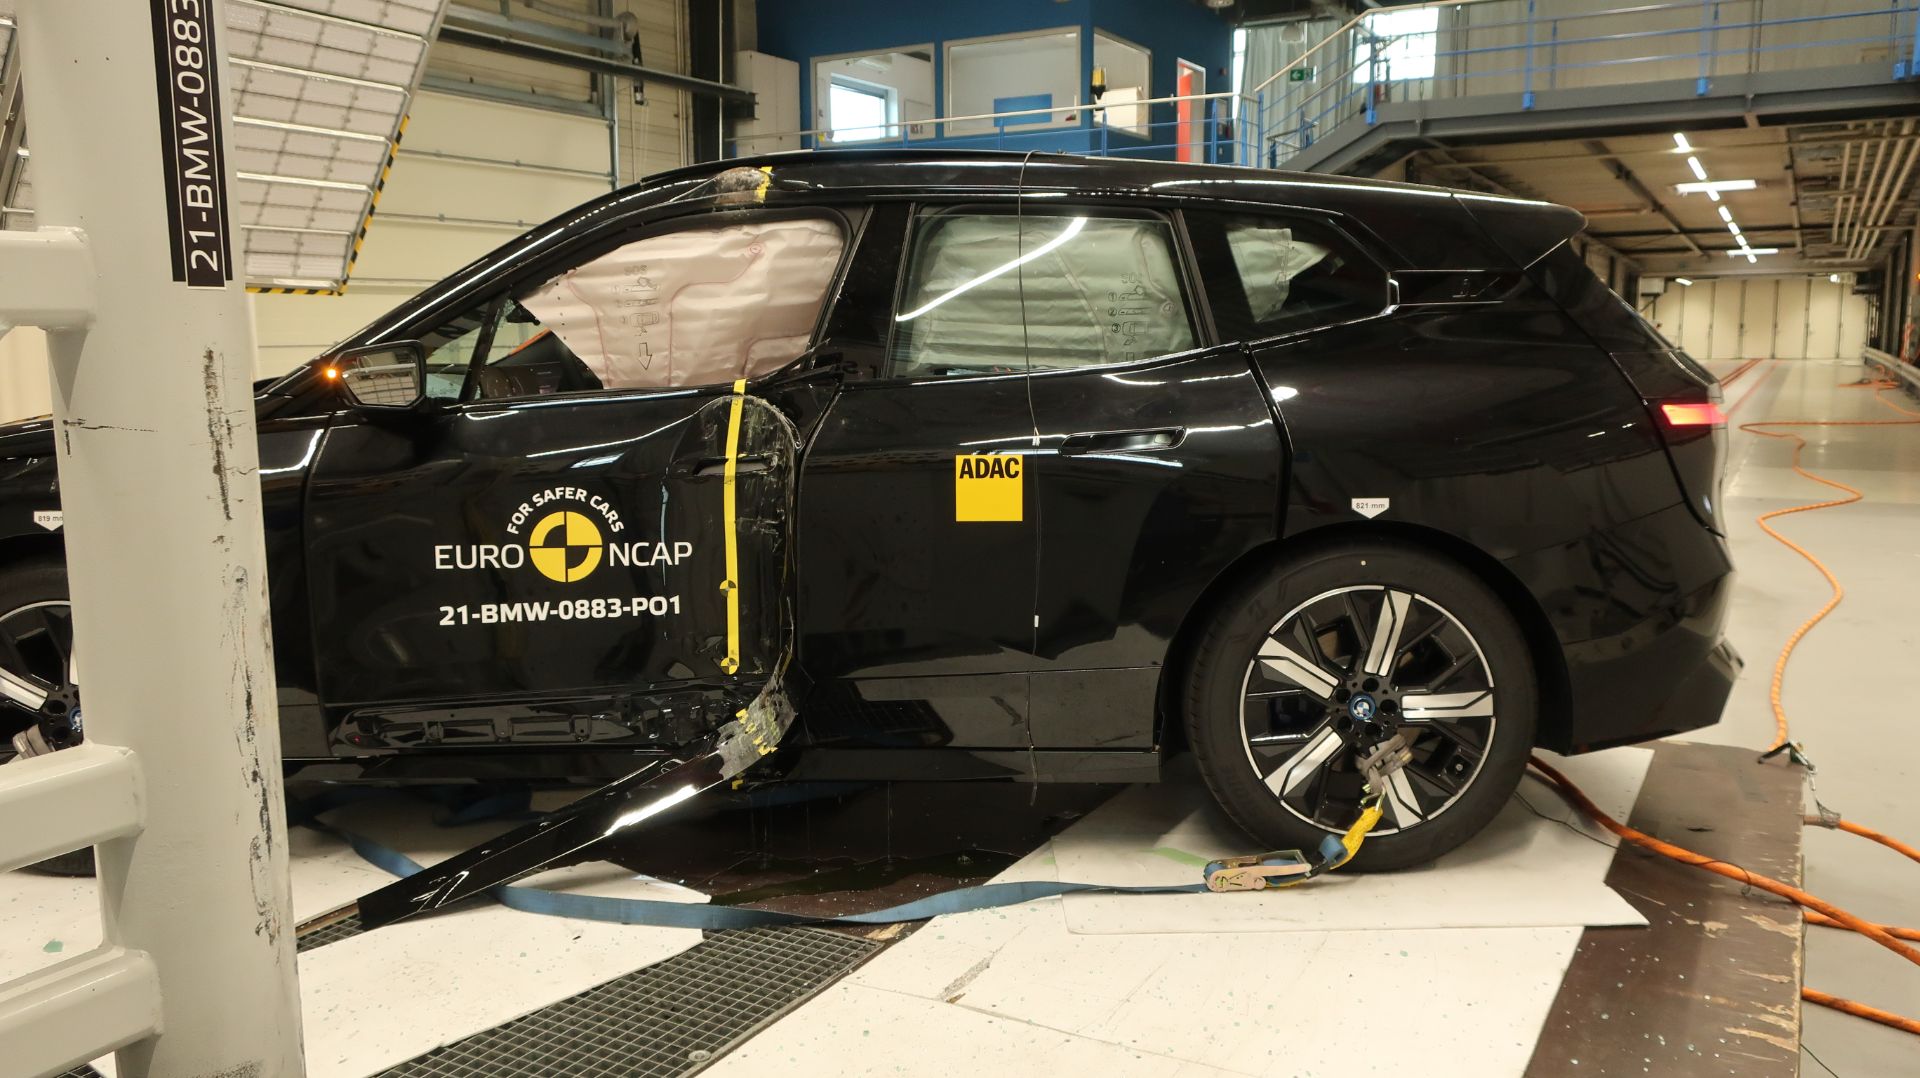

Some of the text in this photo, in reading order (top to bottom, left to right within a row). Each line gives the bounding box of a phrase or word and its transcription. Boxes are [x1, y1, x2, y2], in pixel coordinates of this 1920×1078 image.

[959, 457, 1020, 479] ADAC
[506, 486, 625, 535] FOR SAFER CARS
[434, 541, 693, 570] EURO NCAP
